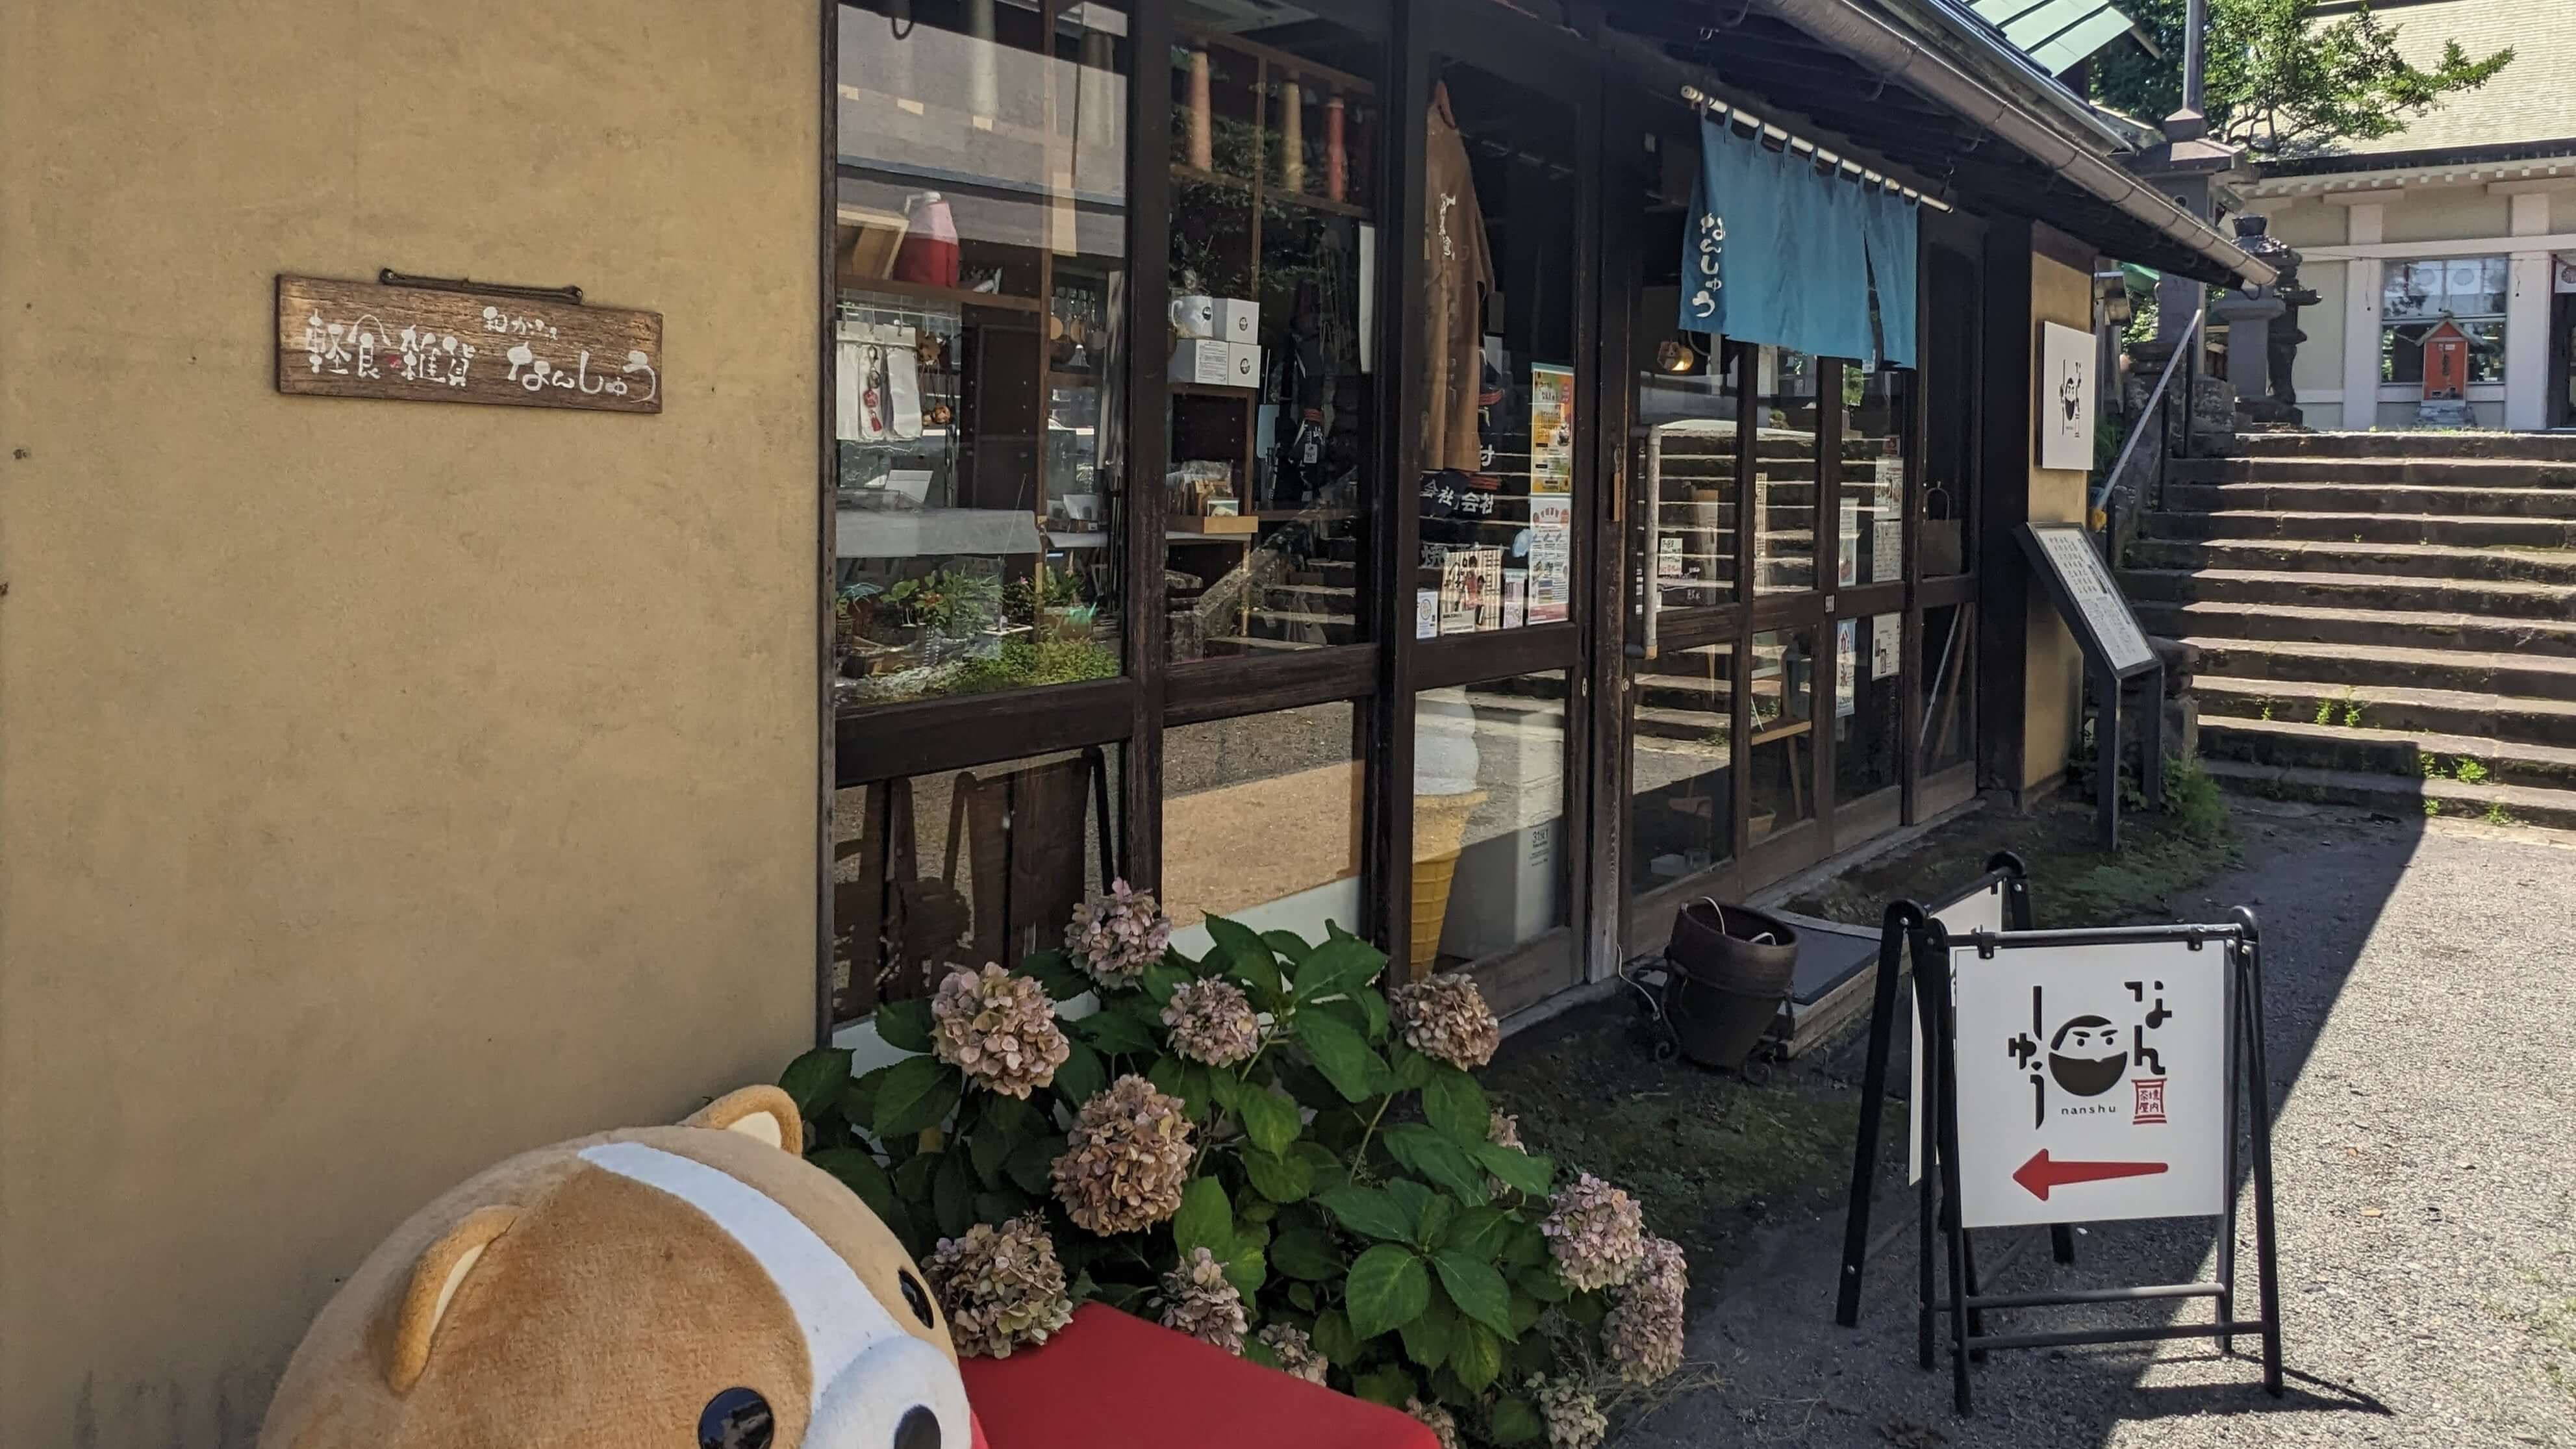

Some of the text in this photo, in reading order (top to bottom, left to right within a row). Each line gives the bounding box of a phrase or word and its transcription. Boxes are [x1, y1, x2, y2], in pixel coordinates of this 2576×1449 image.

[1692, 212, 1726, 318] なんしゅう
[305, 308, 656, 403] 軽食 雑貨 なんしゅう
[2061, 1103, 2116, 1115] nanshu
